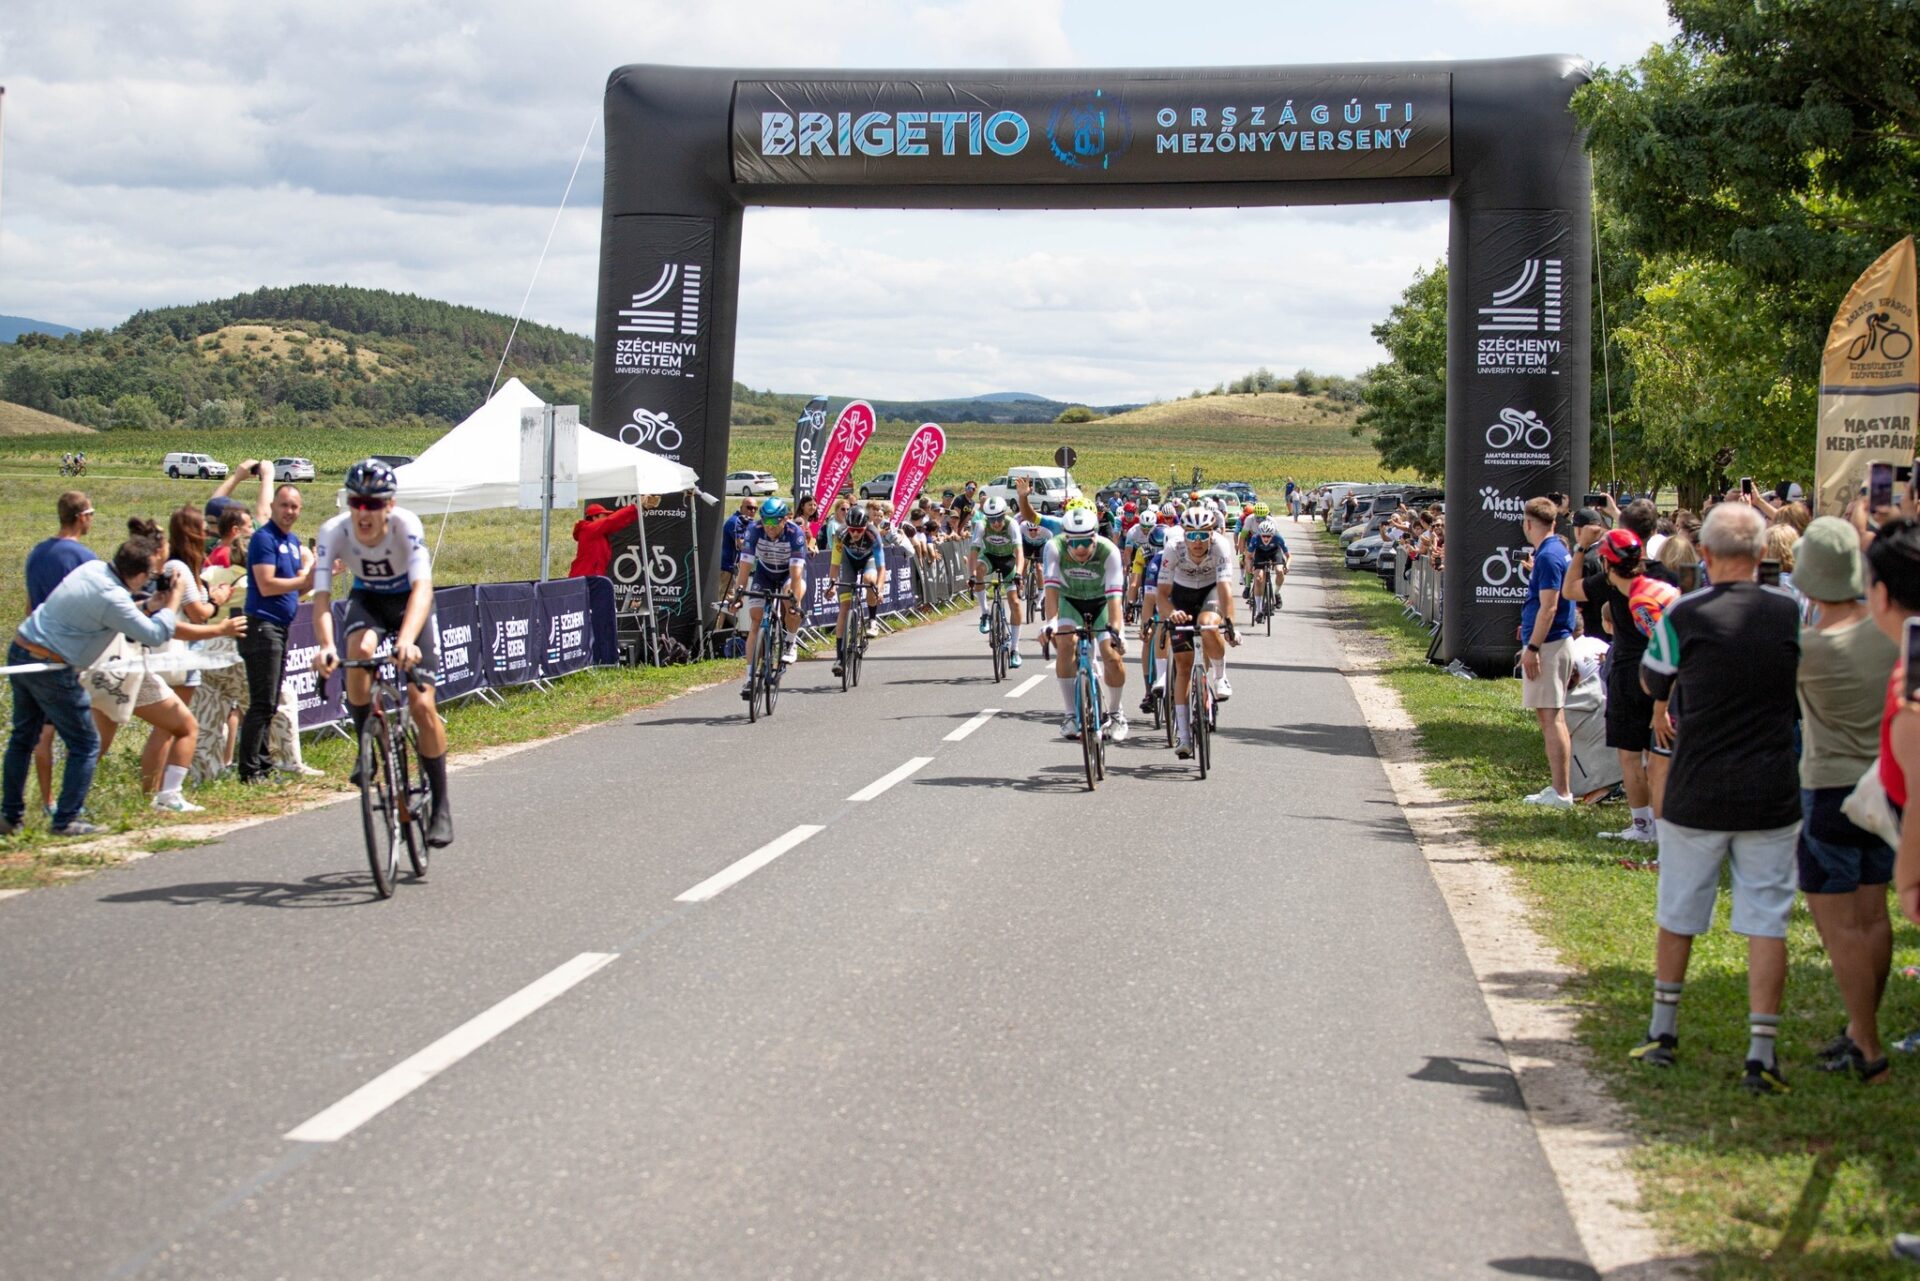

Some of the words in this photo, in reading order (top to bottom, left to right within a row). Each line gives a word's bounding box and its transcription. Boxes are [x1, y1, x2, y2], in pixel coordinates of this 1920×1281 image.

[1156, 98, 1413, 128] ORSZÁGÚTI
[761, 110, 1029, 157] BRIGETIO
[1156, 126, 1412, 154] MEZŐNYVERSENY
[616, 337, 697, 356] SZÉCHENYI
[1477, 336, 1560, 353] SZÉCHENYI
[615, 353, 682, 368] EGYETEM
[1477, 353, 1547, 365] EGYETEM
[615, 367, 650, 375] UNIVERSITY
[1843, 416, 1910, 433] MAGYAR
[1825, 432, 1913, 452] KERÉKPÁRO
[817, 455, 851, 518] MBULANCE
[643, 508, 687, 519] yarország
